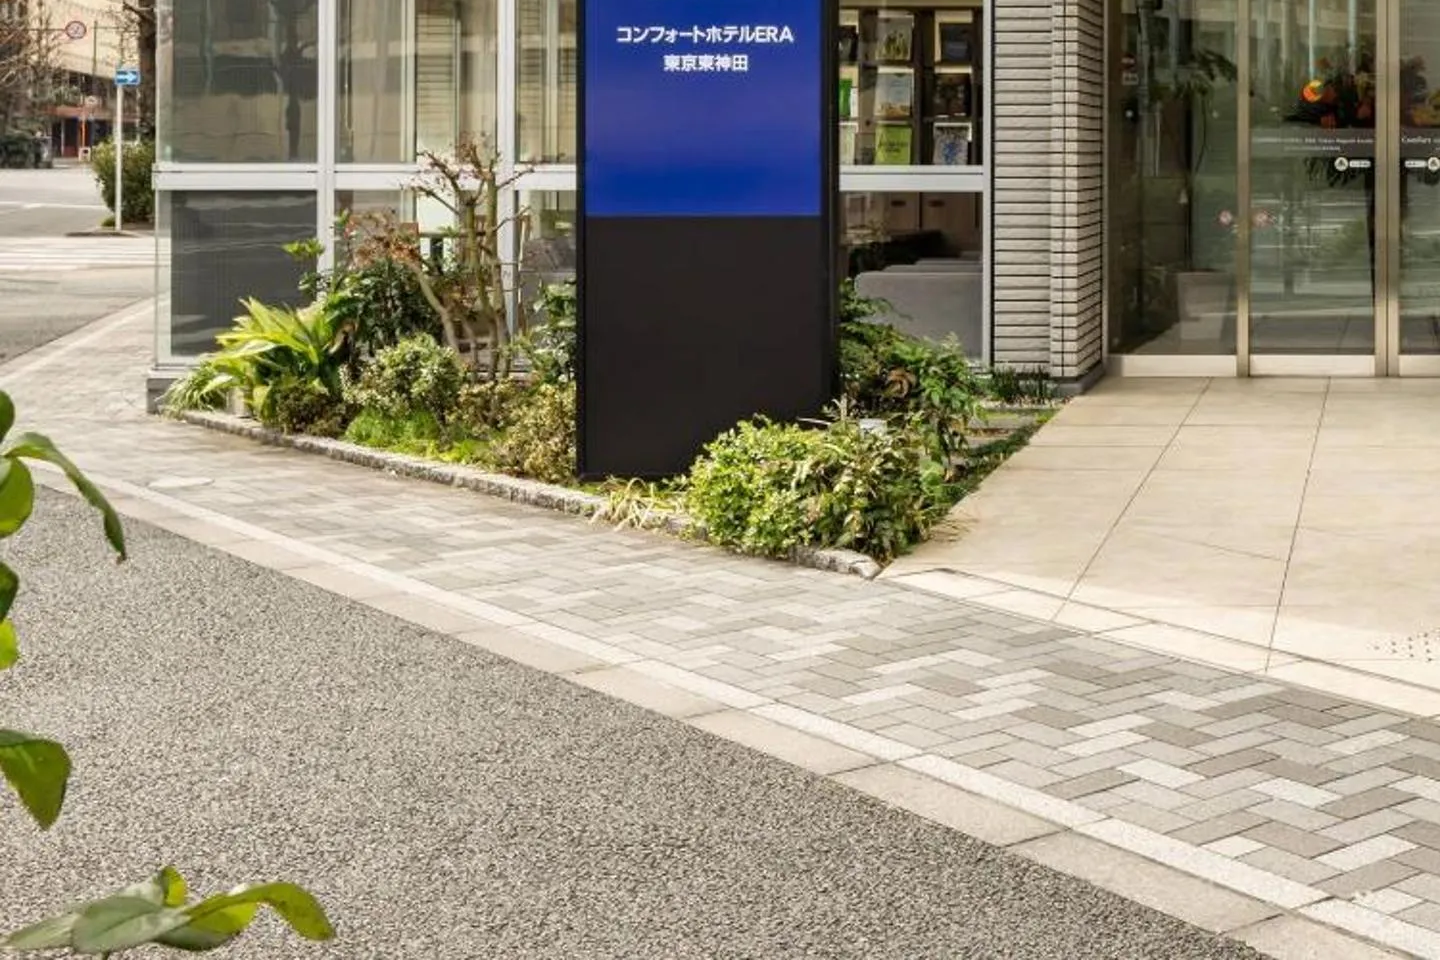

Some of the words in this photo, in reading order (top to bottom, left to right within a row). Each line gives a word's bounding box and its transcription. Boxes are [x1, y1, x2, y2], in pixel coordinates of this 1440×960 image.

[616, 25, 795, 44] コンフォートホテルERA
[663, 53, 749, 73] 東京東神田
